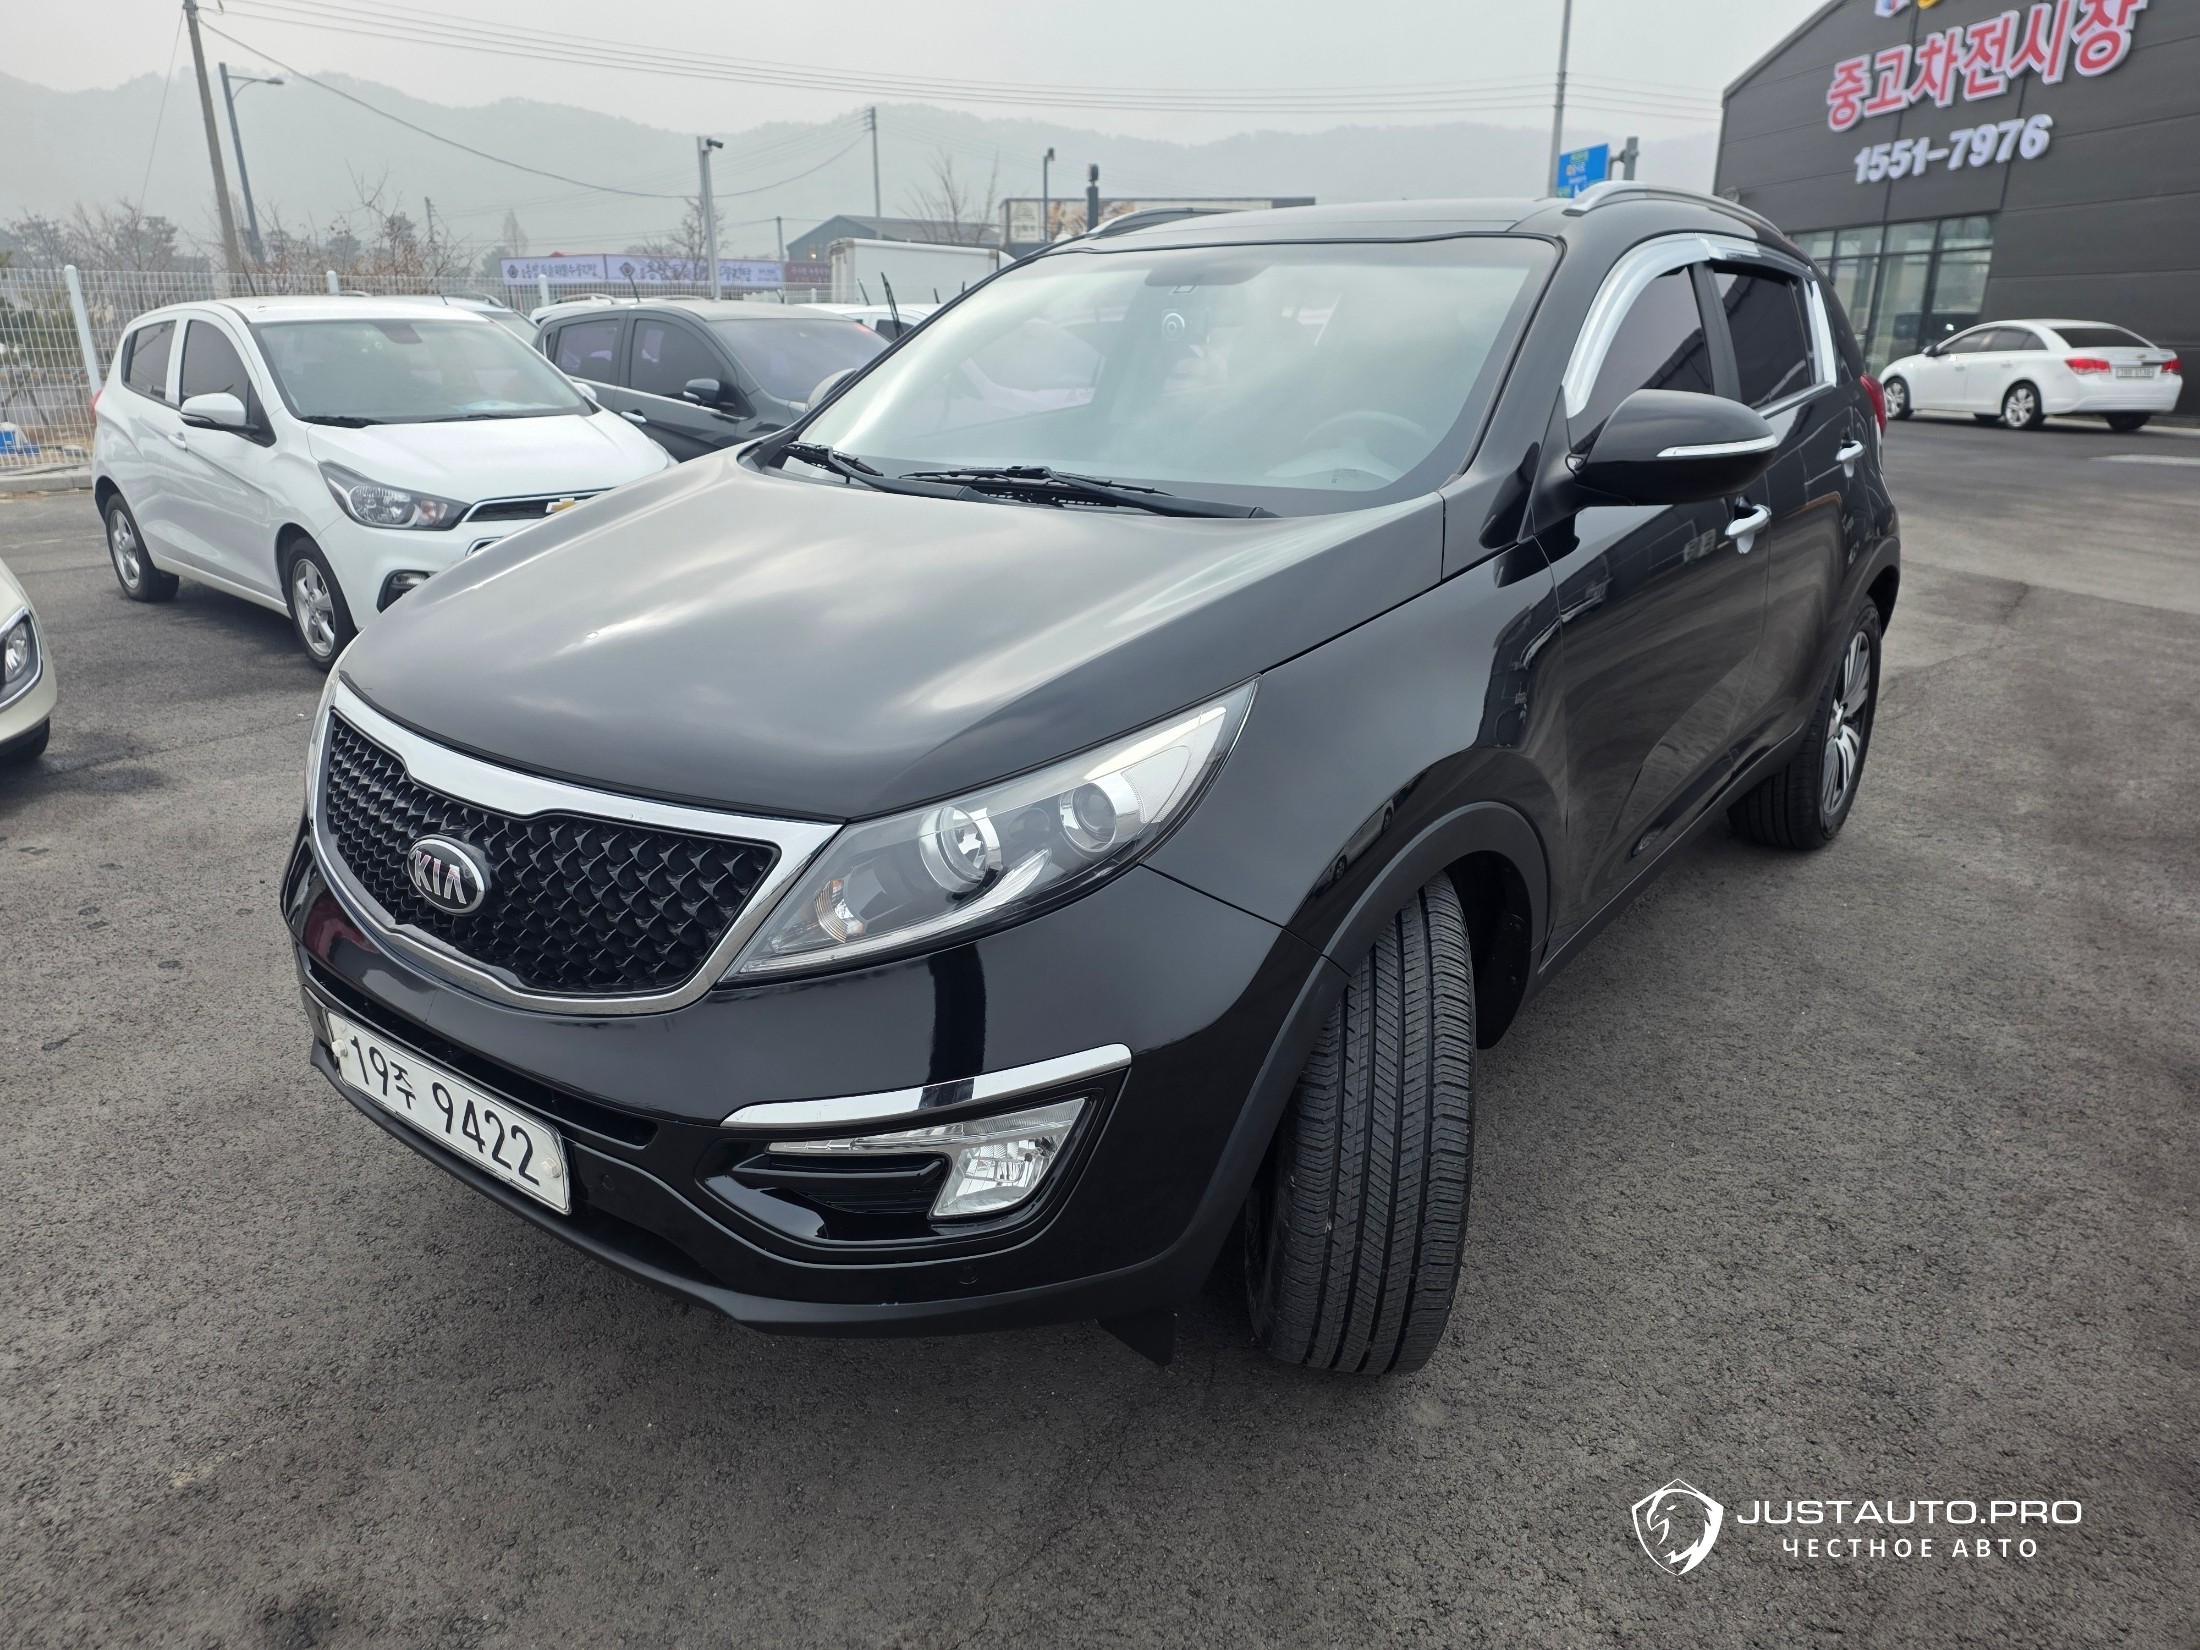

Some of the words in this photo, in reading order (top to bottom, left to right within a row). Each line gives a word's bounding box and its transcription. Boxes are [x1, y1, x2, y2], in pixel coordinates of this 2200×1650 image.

[1826, 0, 2149, 132] 중고차전시장
[1854, 114, 2053, 184] 1551-7976
[414, 849, 467, 905] KIA
[350, 1034, 417, 1110] 19주
[431, 1081, 540, 1186] 9422
